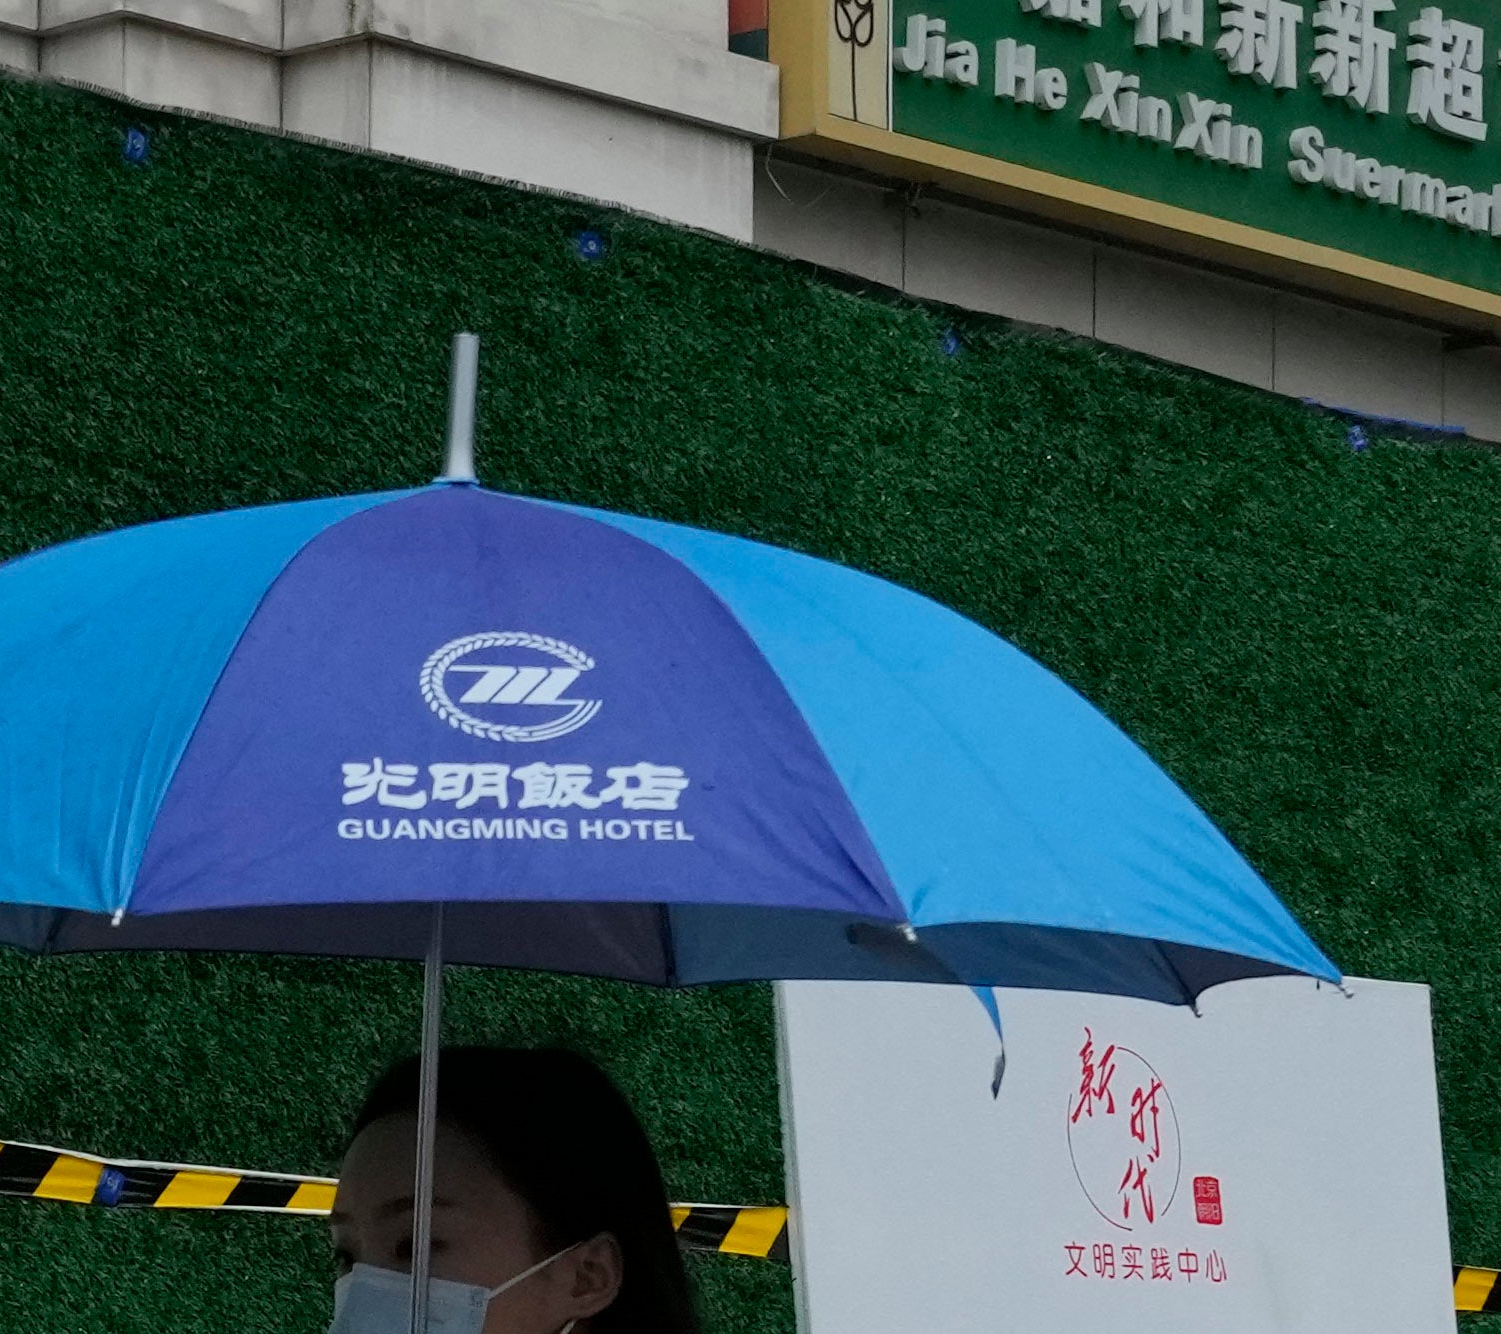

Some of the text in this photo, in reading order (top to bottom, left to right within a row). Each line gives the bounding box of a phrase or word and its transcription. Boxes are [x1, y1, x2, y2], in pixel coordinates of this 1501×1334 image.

[893, 13, 979, 86] Jia
[994, 38, 1068, 111] He
[340, 757, 689, 811] 光明飯店
[337, 817, 694, 841] GUANGMING HOTEL
[1064, 1242, 1227, 1283] 文明实践中心
